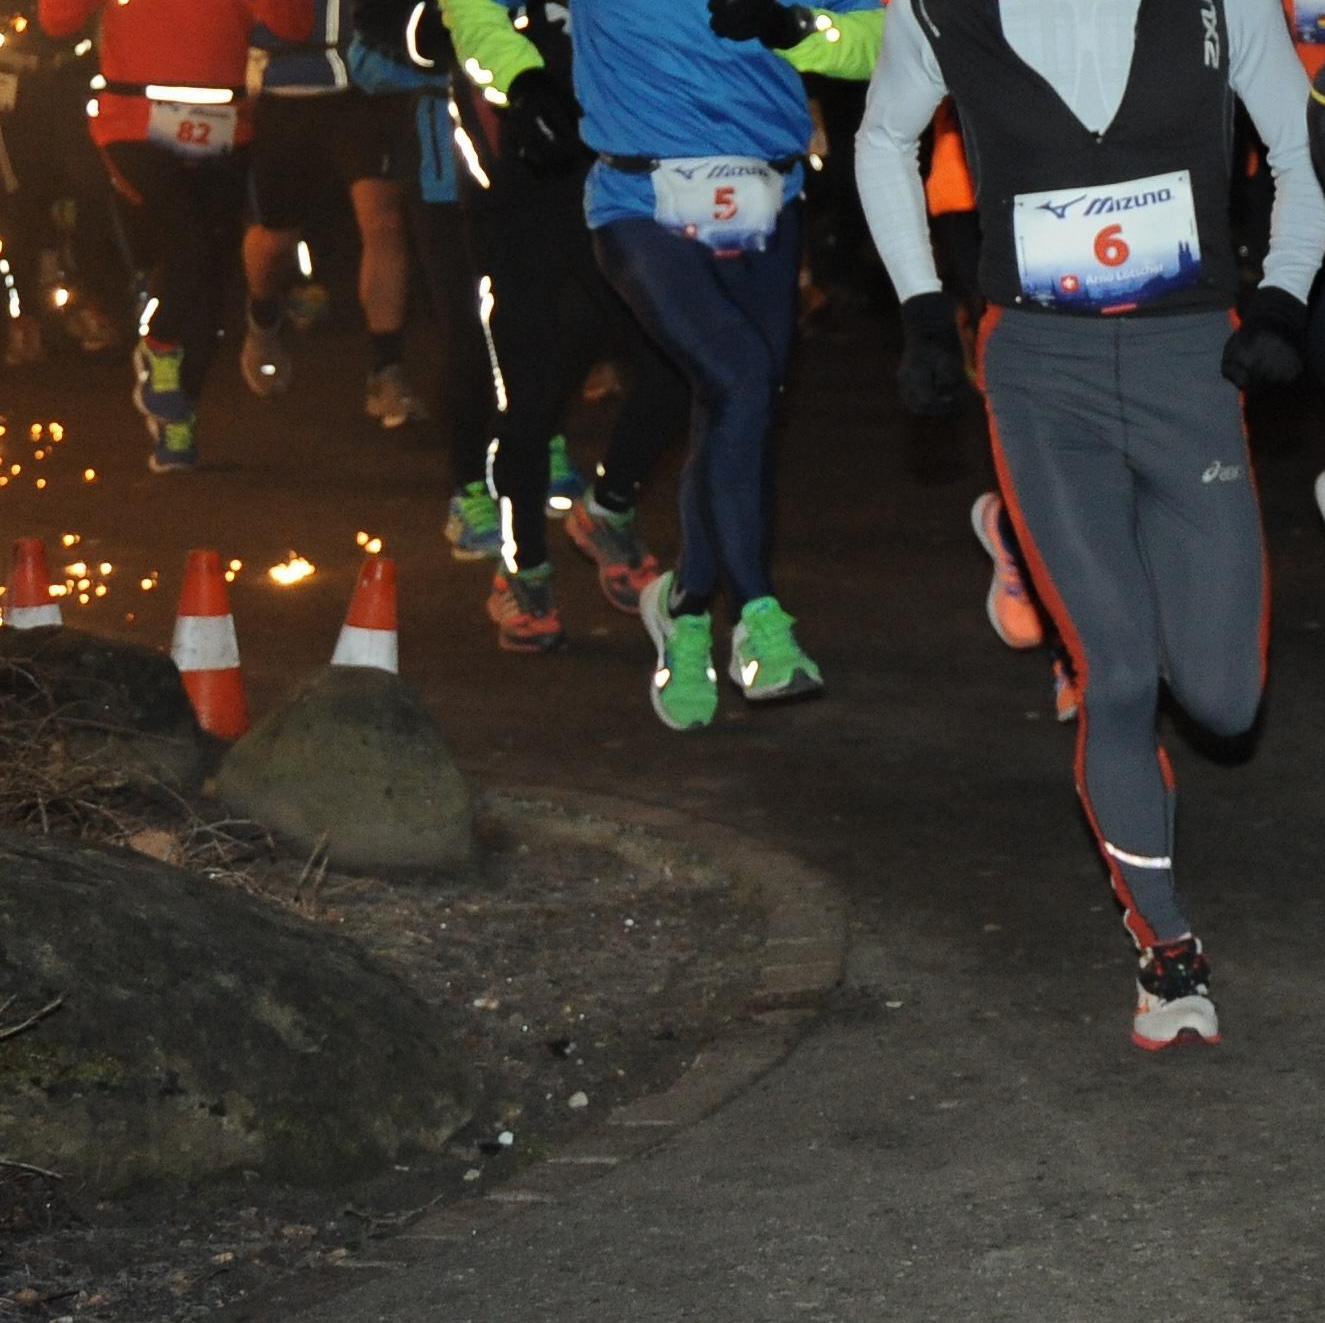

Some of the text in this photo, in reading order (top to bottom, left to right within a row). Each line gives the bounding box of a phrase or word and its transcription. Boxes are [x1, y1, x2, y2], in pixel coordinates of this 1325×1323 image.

[176, 119, 212, 145] 82
[714, 186, 738, 222] 5
[1094, 223, 1131, 268] 6
